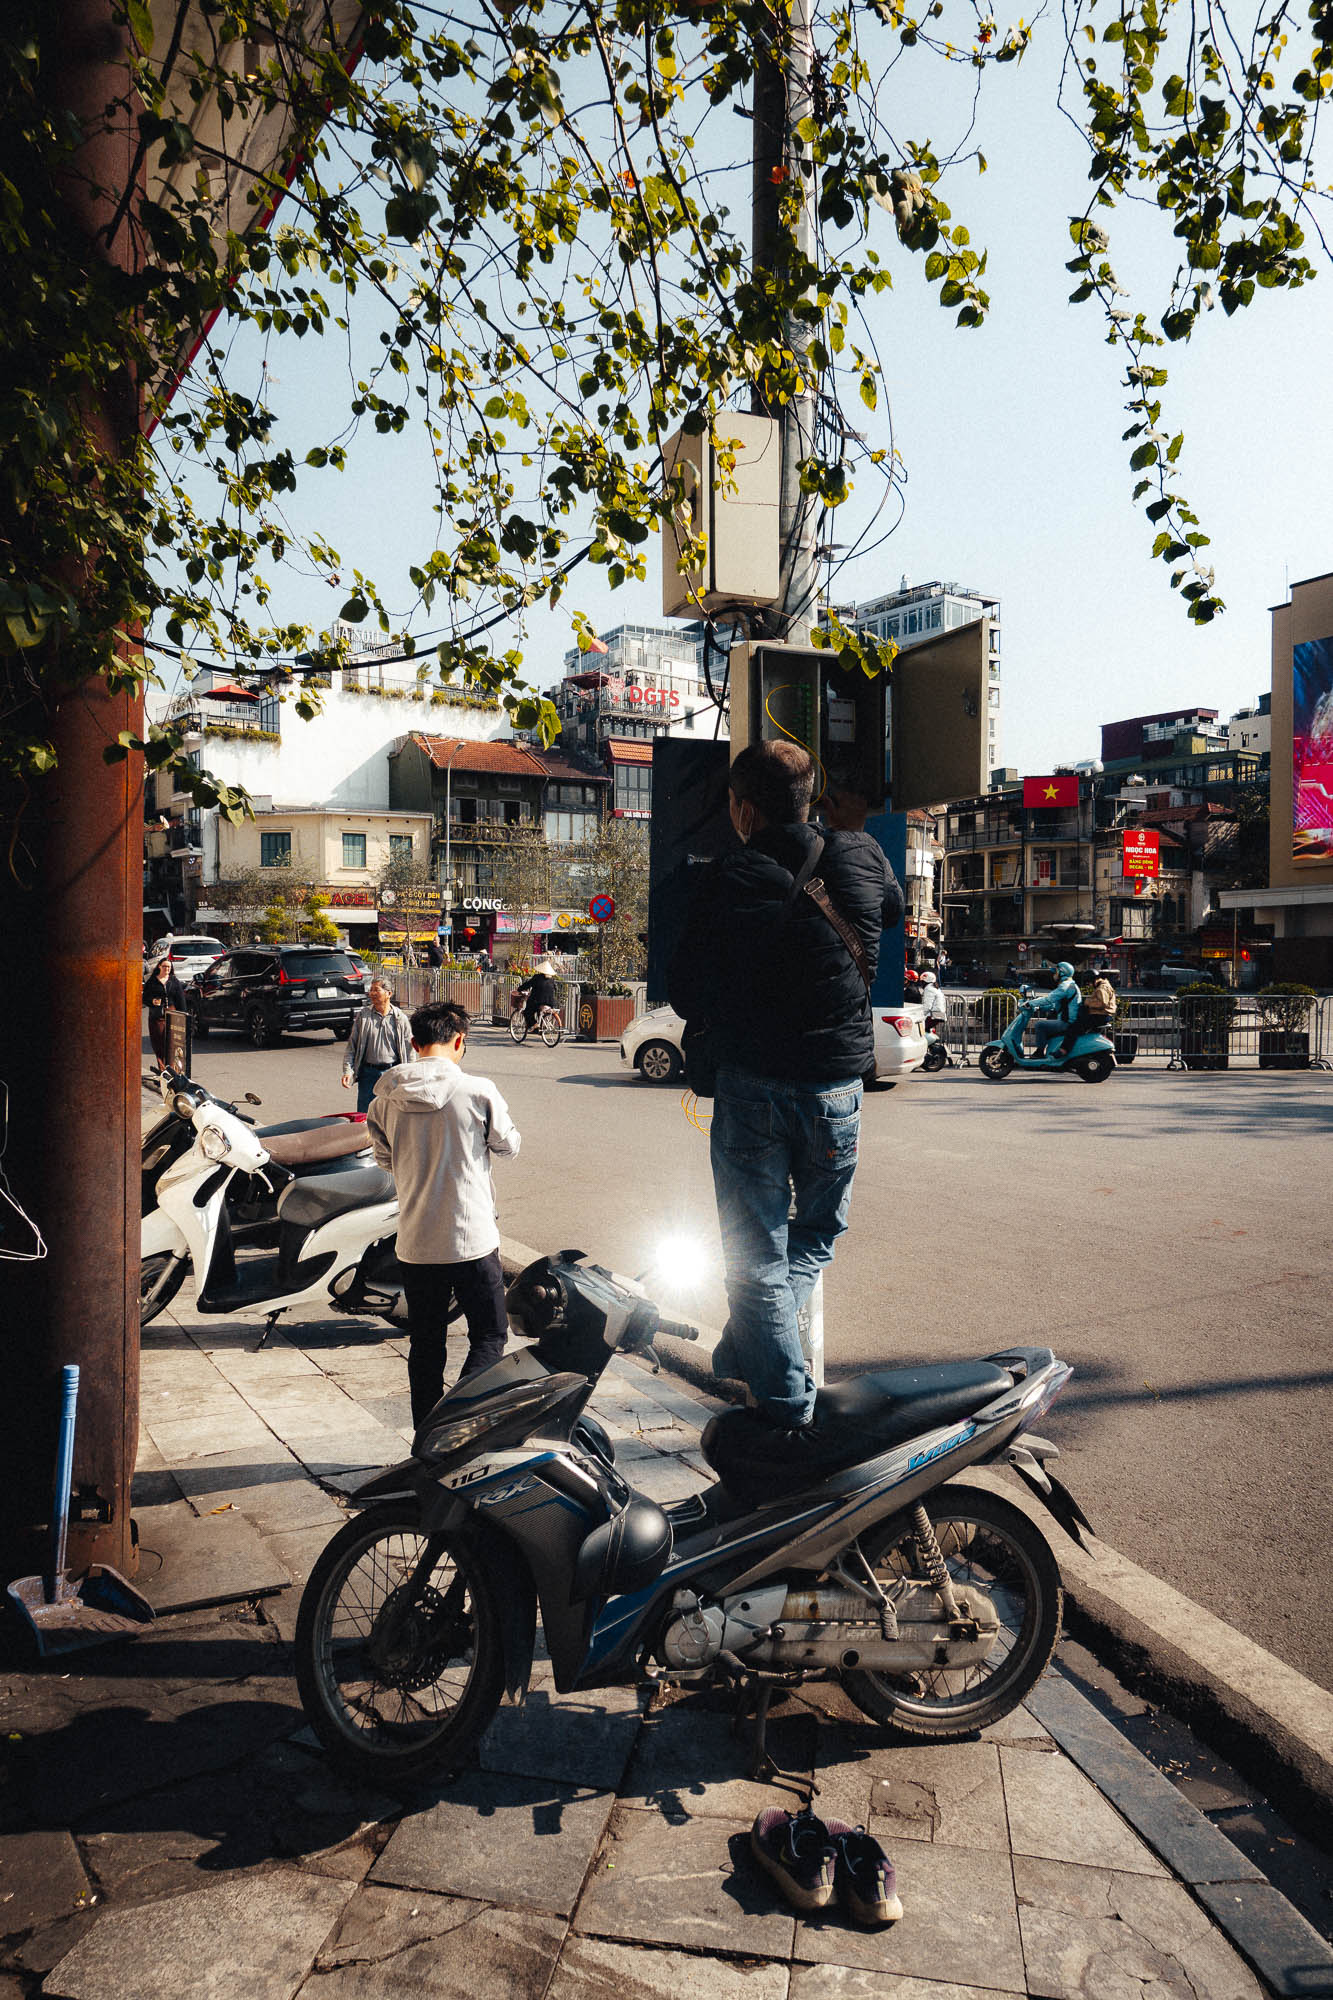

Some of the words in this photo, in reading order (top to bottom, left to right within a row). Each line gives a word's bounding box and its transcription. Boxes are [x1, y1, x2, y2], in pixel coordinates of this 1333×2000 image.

[629, 685, 680, 707] DGTS
[328, 893, 374, 905] AGEL
[463, 896, 501, 912] CỘNG
[450, 1464, 490, 1488] 110
[473, 1474, 536, 1509] RSX
